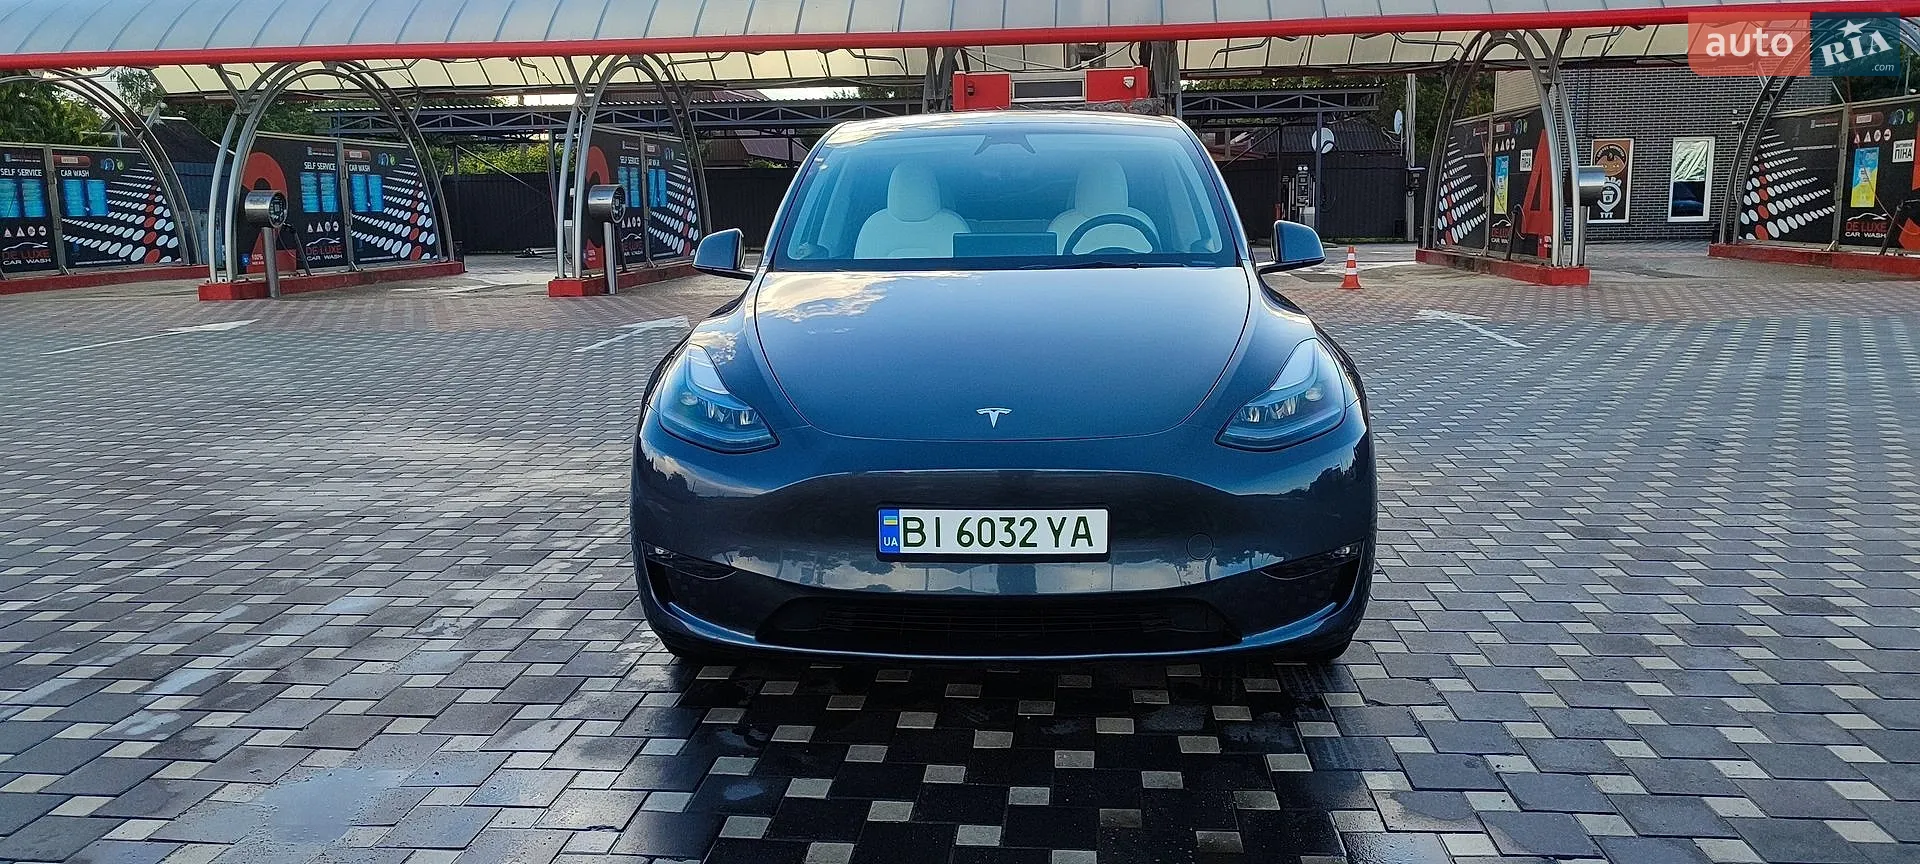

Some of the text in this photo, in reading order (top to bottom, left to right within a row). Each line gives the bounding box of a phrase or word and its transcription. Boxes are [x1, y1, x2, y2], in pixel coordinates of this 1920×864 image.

[1894, 148, 1913, 160] ПІНА
[304, 161, 336, 171] SELF SERVICE
[0, 168, 43, 177] SELF SERVICE
[60, 169, 90, 177] CAR WASH
[1845, 220, 1887, 232] DE LUXE
[1864, 231, 1887, 239] WASH
[902, 516, 1094, 548] BI 6032 YA
[883, 536, 899, 547] UA
